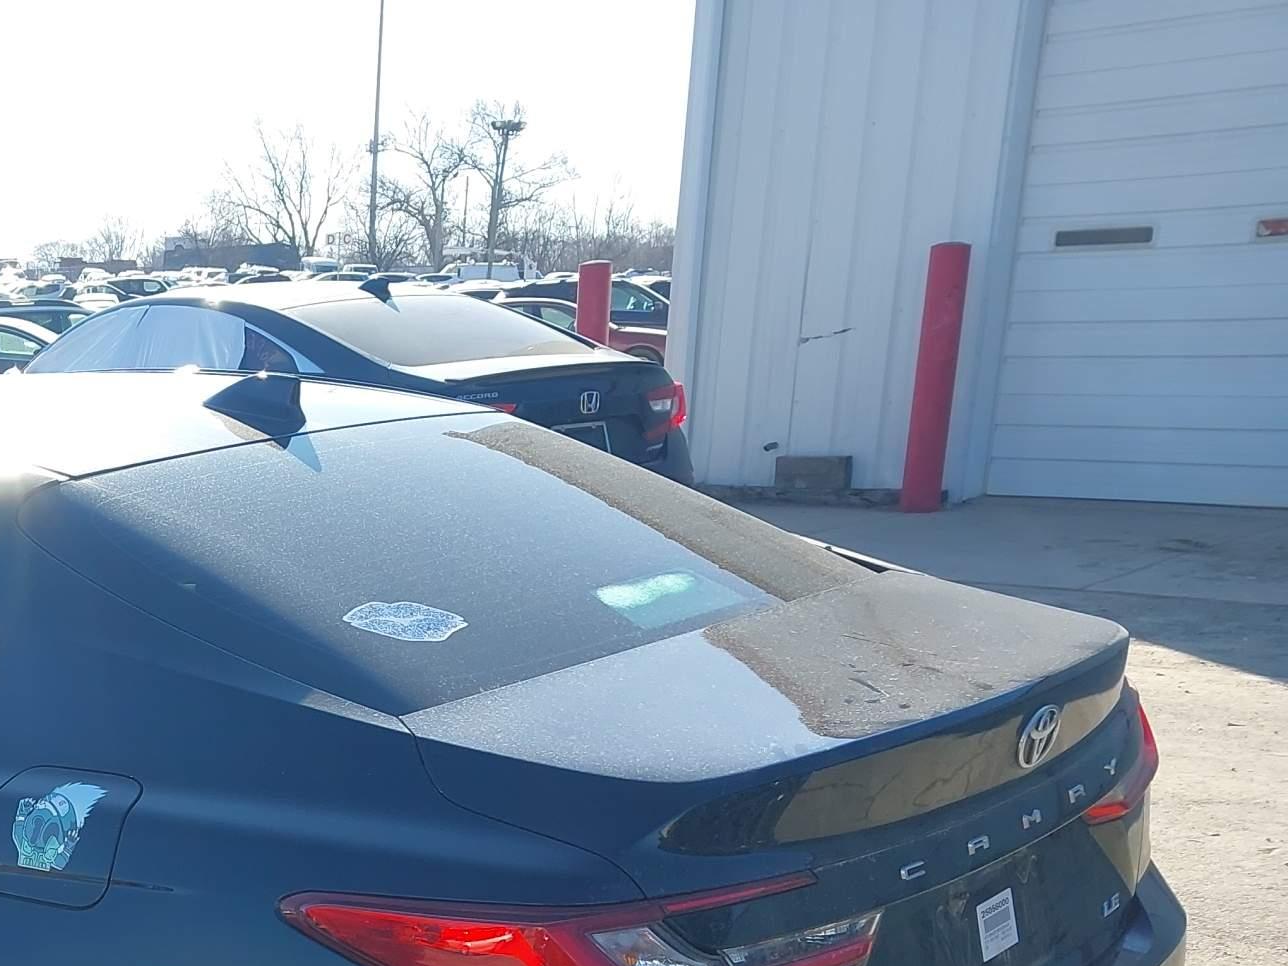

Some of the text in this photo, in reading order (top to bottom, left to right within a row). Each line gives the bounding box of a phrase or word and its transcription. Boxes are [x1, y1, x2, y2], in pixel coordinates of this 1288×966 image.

[327, 233, 335, 245] D
[343, 233, 352, 245] C
[900, 757, 1117, 880] CAMRY
[1103, 892, 1121, 918] LE
